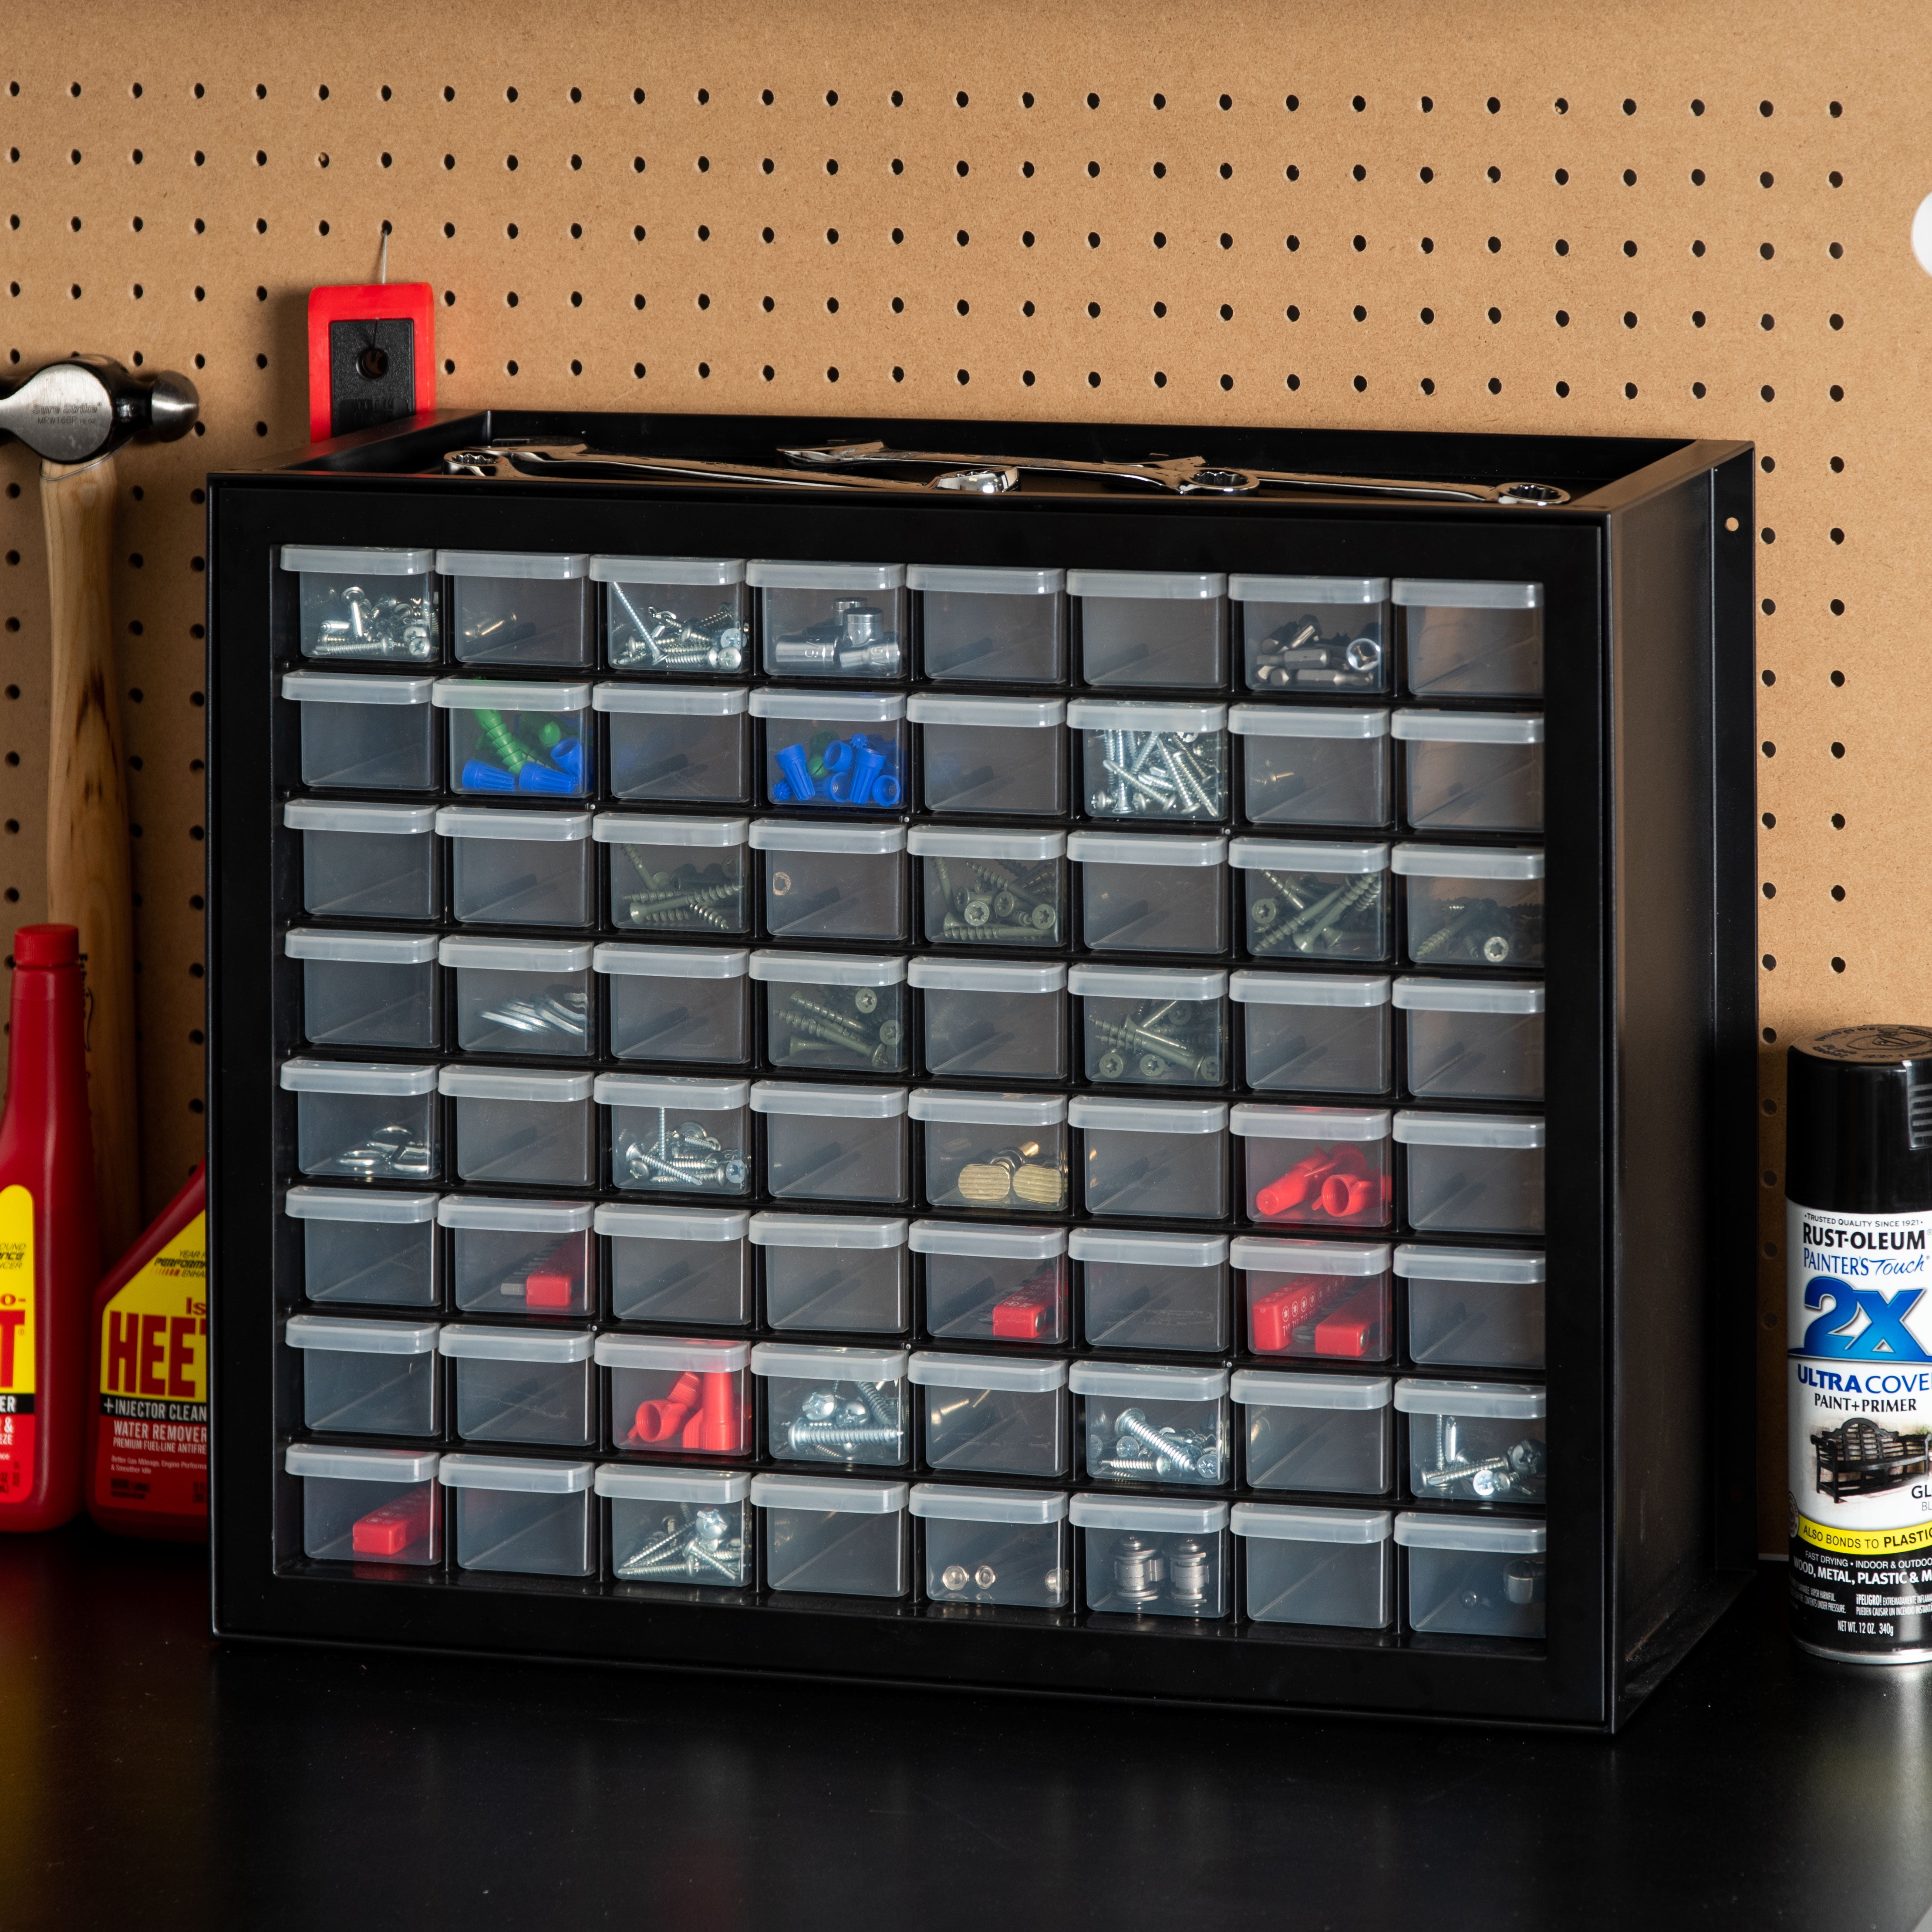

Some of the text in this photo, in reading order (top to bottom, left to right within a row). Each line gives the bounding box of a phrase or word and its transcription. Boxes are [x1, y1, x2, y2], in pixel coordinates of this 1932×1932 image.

[33, 404, 60, 414] Sure
[1807, 1213, 1836, 1224] TRUSTED
[1838, 1219, 1872, 1227] QUALITY
[1803, 1222, 1925, 1250] RUST-OLEUM
[1804, 1247, 1925, 1276] PAINTER'S Touch
[1804, 1276, 1926, 1361] 2X
[107, 1311, 206, 1398] HEE
[1798, 1364, 1932, 1394] ULTRA COVE
[114, 1420, 207, 1443] WATER REMOVER
[113, 1438, 142, 1450] PREMIUM
[111, 1455, 126, 1463] Better
[162, 1460, 179, 1469] Engine
[116, 1465, 140, 1473] Smoother
[1804, 1525, 1823, 1541] ALSO
[1826, 1534, 1861, 1549] BONDS
[1865, 1539, 1879, 1548] TO
[1805, 1551, 1819, 1561] FAST
[1821, 1555, 1848, 1567] DRYING
[1855, 1560, 1888, 1569] INDOOR
[1794, 1556, 1816, 1578] WOOD,
[1818, 1566, 1855, 1585] METAL,
[1858, 1571, 1908, 1585] PLASTIC
[1909, 1572, 1919, 1584] &
[1856, 1594, 1882, 1606] ¡PELIGRO!
[1856, 1607, 1872, 1616] PUEDEN
[1873, 1607, 1888, 1616] CAUSAR
[1889, 1608, 1895, 1616] UN
[1838, 1620, 1894, 1636] NET WT. 12 OZ. 340g
